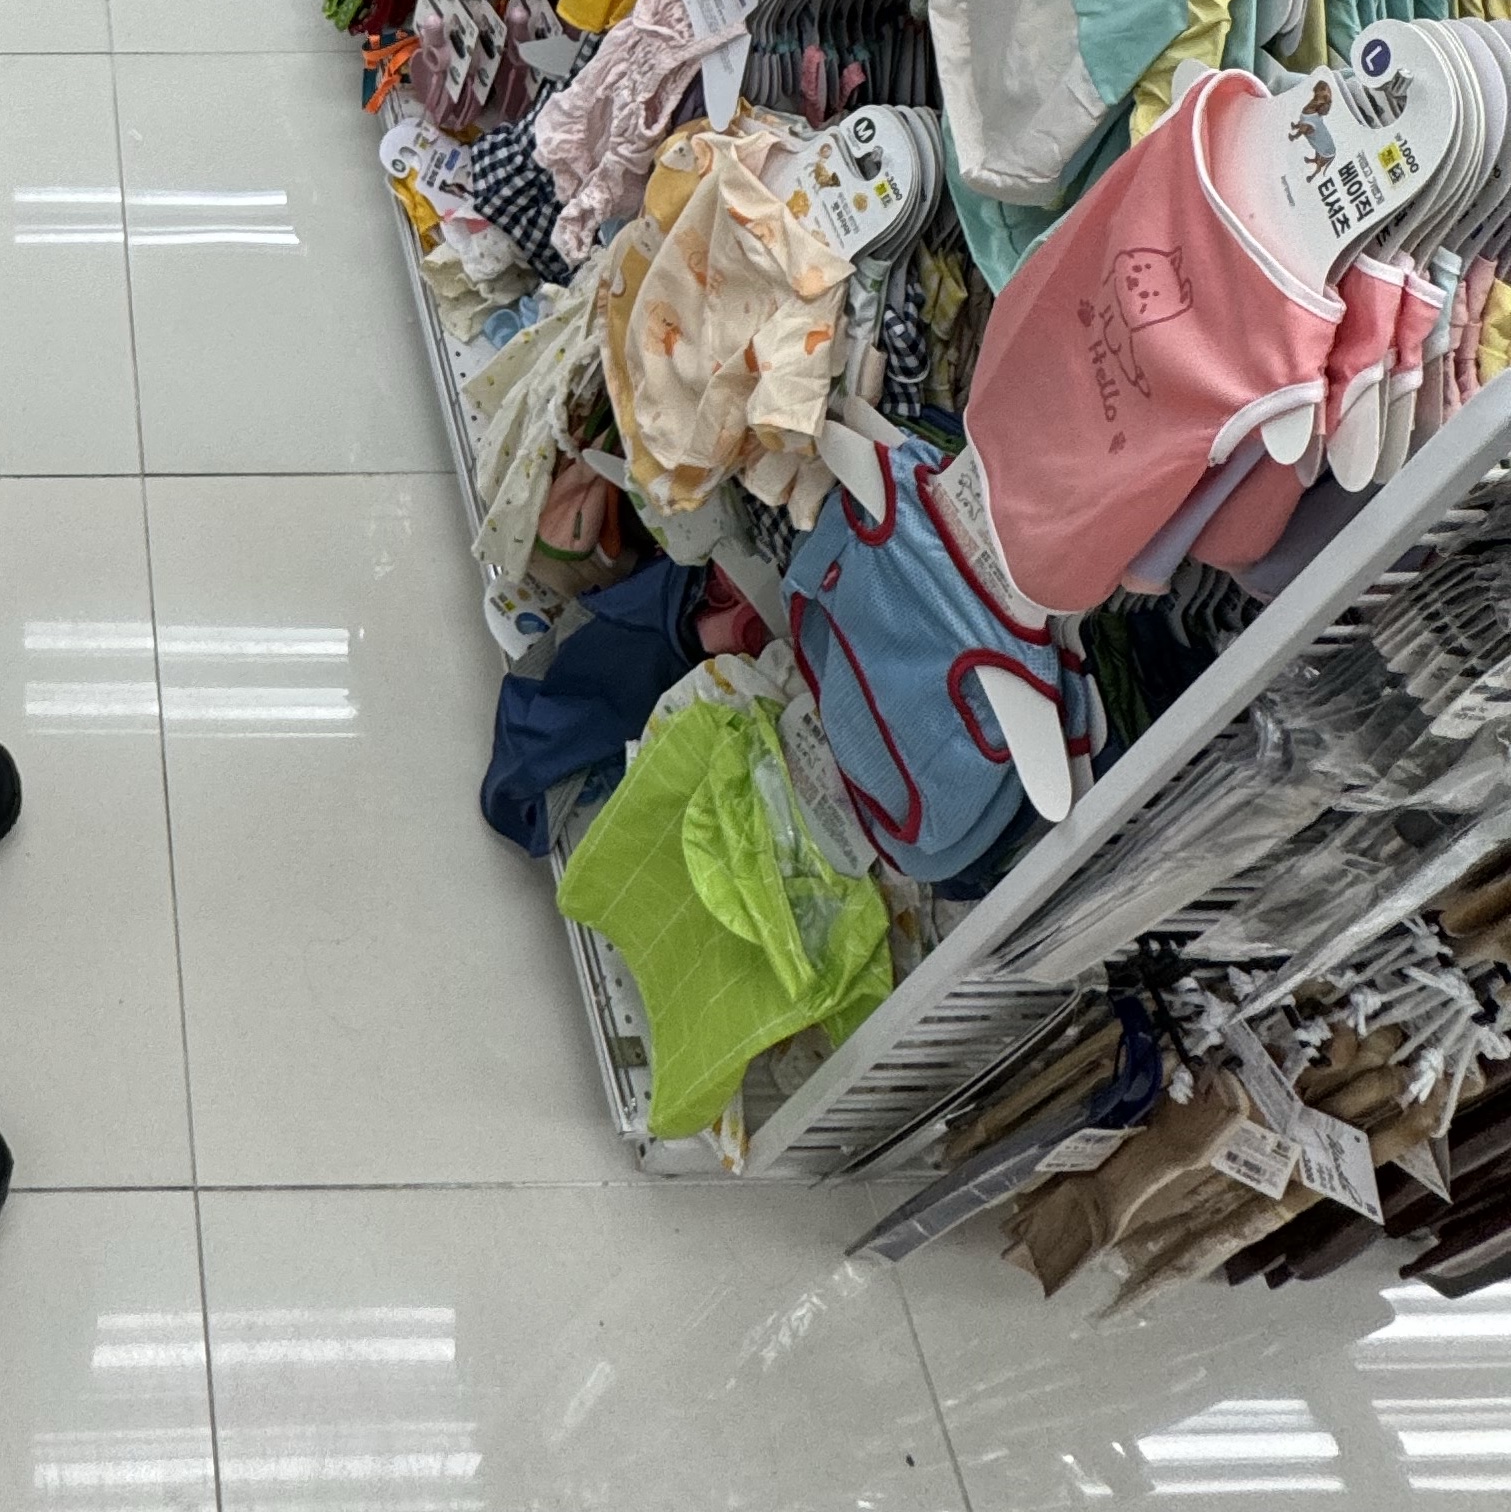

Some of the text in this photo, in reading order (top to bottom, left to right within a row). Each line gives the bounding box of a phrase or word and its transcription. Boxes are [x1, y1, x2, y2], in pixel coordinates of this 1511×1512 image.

[1366, 44, 1383, 72] L
[855, 120, 874, 142] M
[1317, 176, 1352, 239] 티셔츠
[1338, 160, 1375, 223] 베이직
[1088, 339, 1121, 423] Hello
